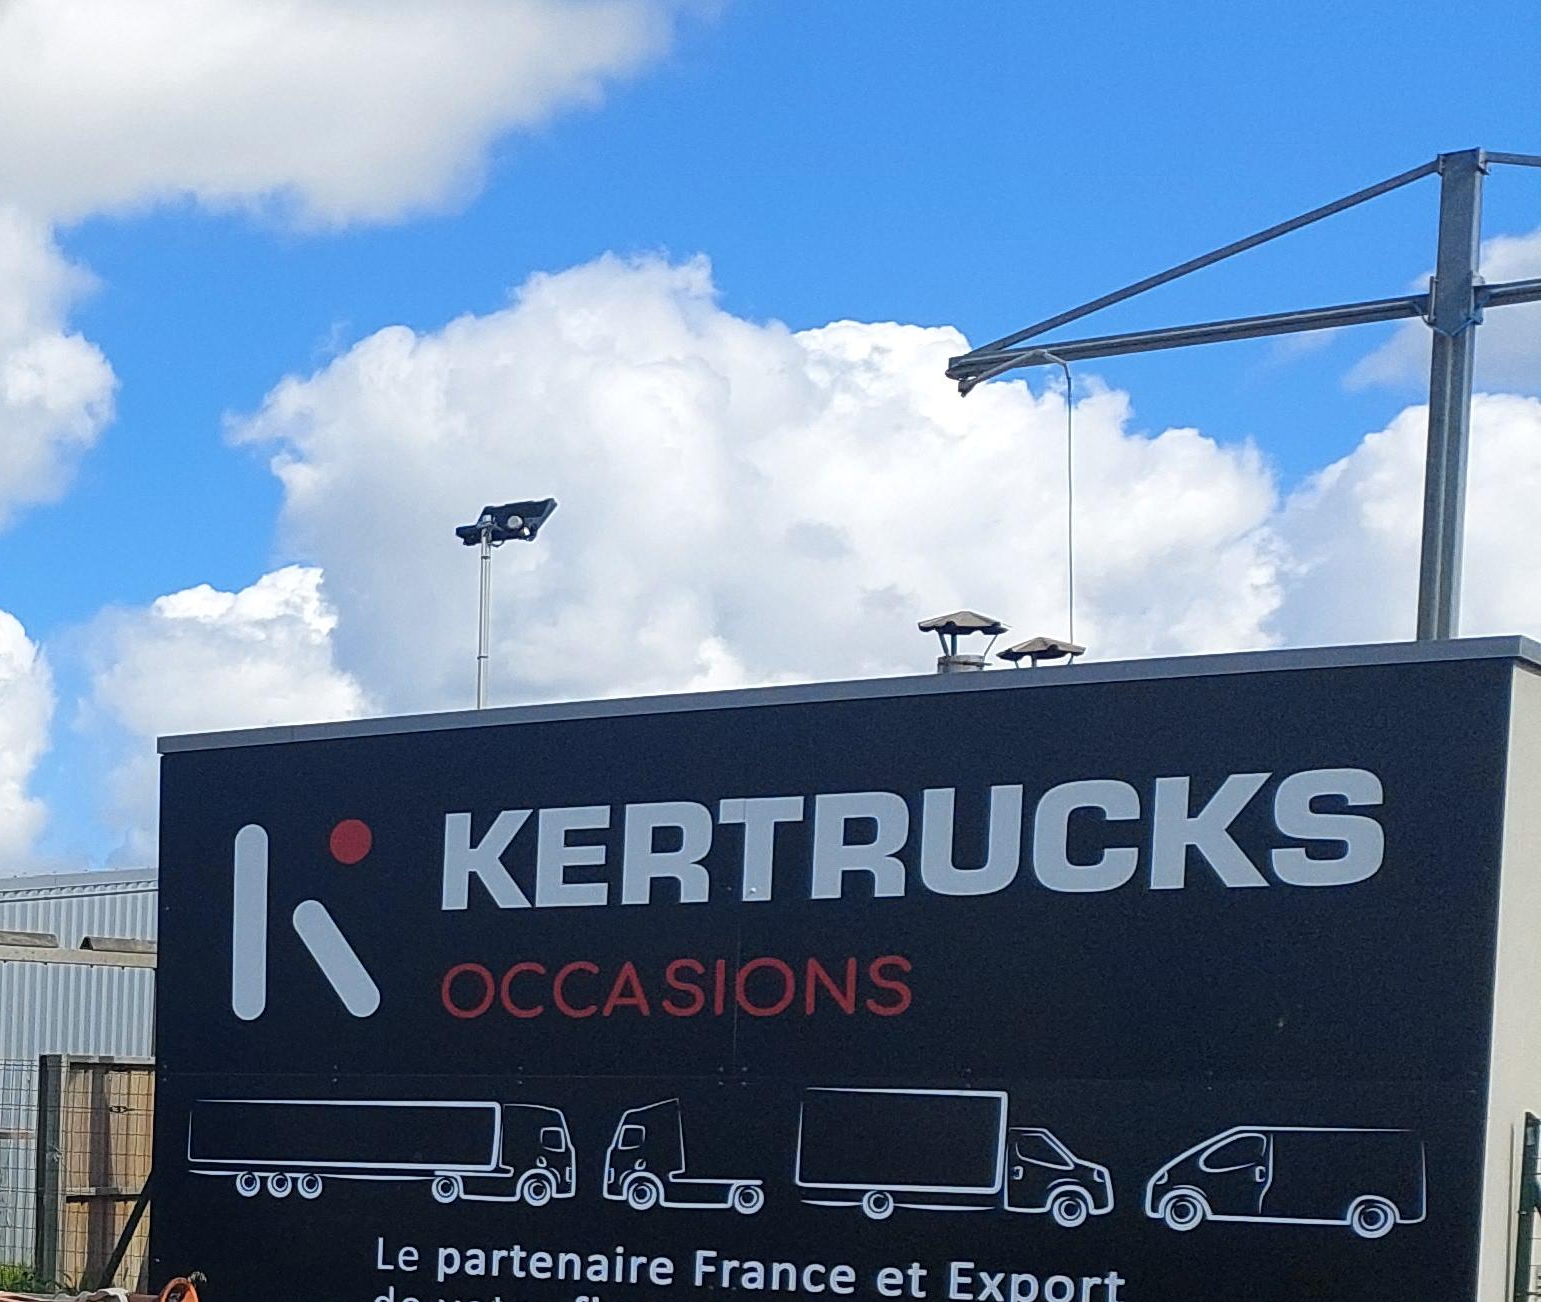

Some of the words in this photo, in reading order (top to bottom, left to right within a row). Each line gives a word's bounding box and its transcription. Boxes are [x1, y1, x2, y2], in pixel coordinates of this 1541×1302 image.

[440, 767, 1386, 912] KERTRUCKS
[440, 954, 914, 1020] OCCASIONS
[377, 1237, 419, 1272] Le
[437, 1245, 674, 1286] partenaire
[694, 1249, 856, 1295] France
[876, 1262, 928, 1298] et
